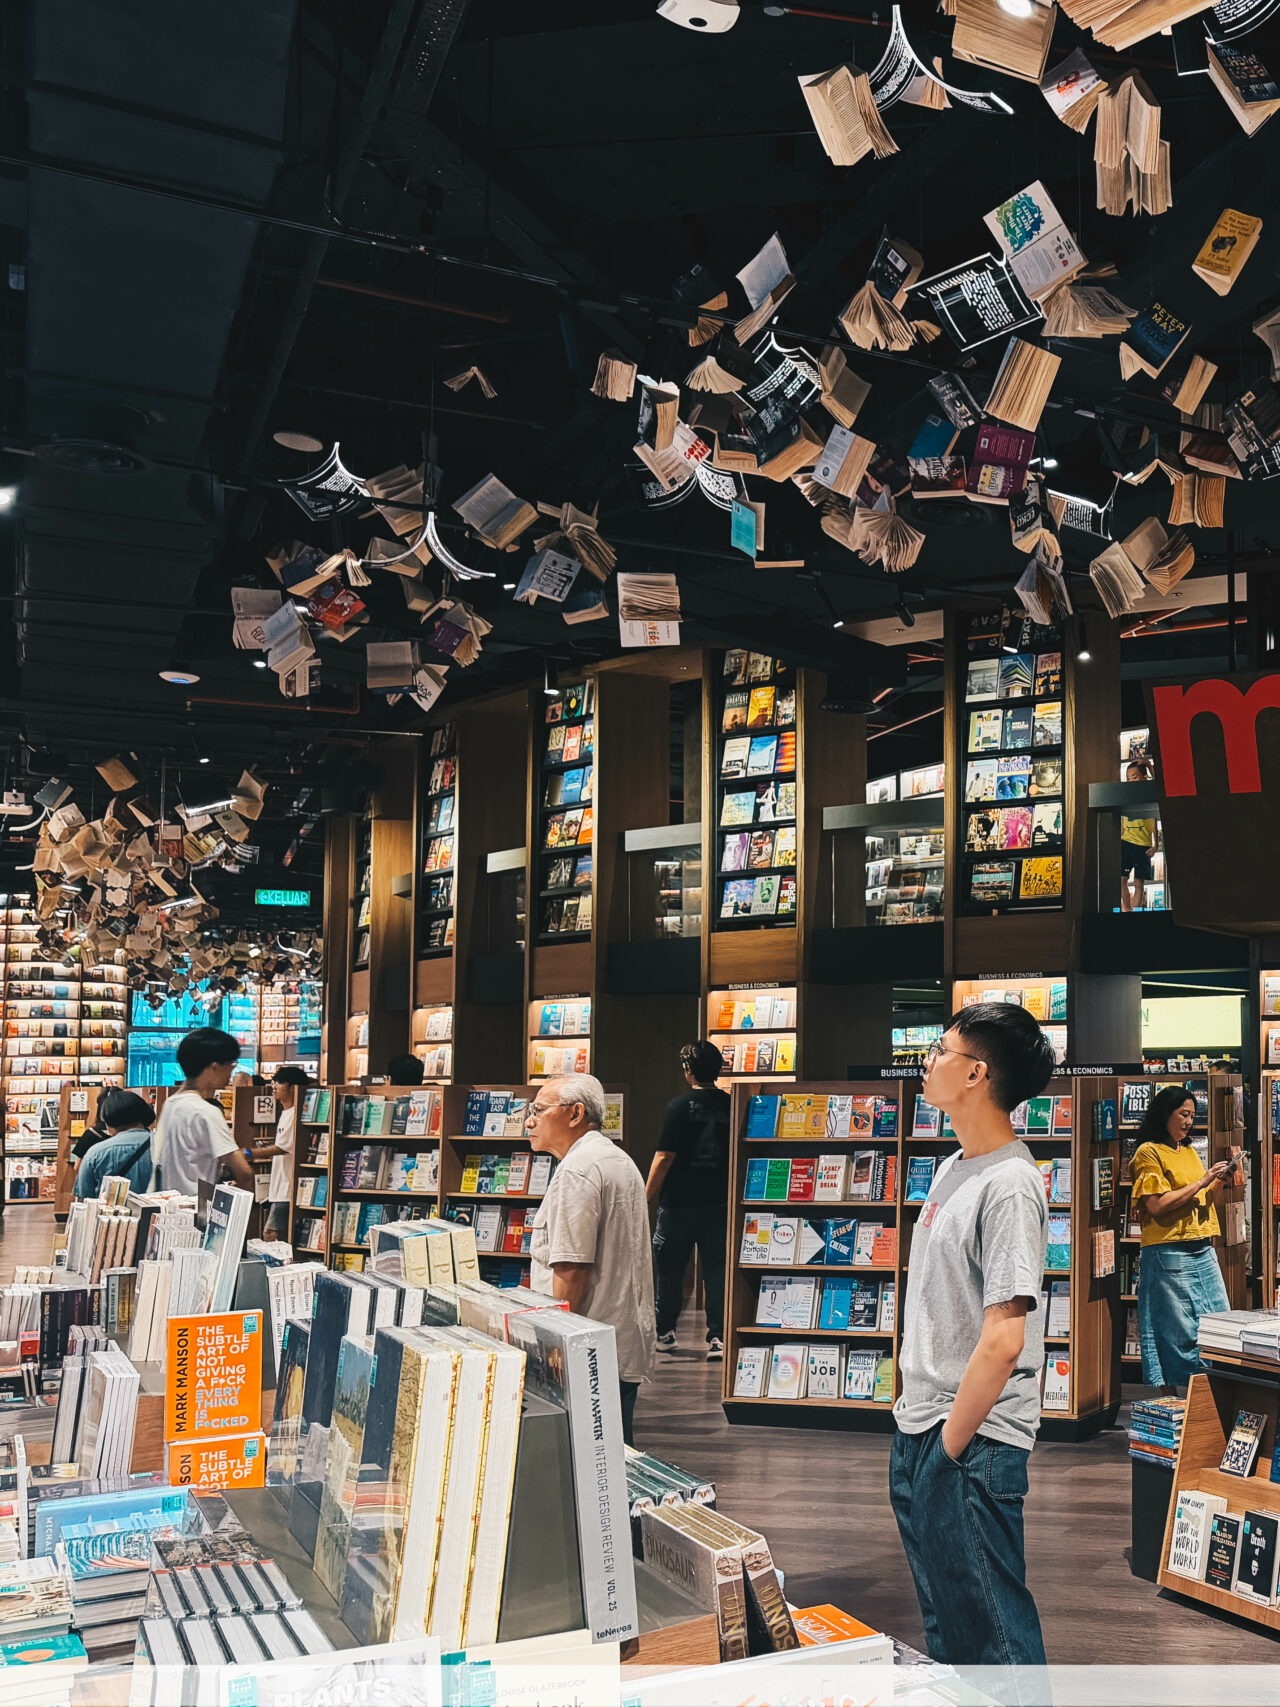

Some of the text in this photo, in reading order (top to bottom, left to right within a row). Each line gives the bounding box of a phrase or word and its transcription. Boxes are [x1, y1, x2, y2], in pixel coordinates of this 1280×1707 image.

[1152, 302, 1185, 332] PETER
[1152, 313, 1176, 334] MAY
[266, 891, 310, 905] KELUAR
[880, 1068, 918, 1077] BUSINESS
[1072, 1066, 1113, 1075] ECONOMICS
[1123, 1083, 1150, 1098] POSS
[489, 1104, 504, 1113] EASY
[1128, 1098, 1149, 1111] IBLE
[469, 1114, 480, 1122] THE
[769, 1160, 789, 1170] YOU
[910, 1165, 932, 1175] QUIET
[875, 1157, 886, 1201] Innovation
[743, 1239, 755, 1247] The
[743, 1246, 768, 1254] Portfolio
[756, 1252, 767, 1260] Life
[196, 1325, 224, 1337] THE
[196, 1333, 250, 1347] SUBTLE
[196, 1344, 250, 1357] ART OF
[196, 1355, 226, 1368] NOT
[849, 1356, 874, 1365] PROJECT
[196, 1365, 246, 1378] GIVING
[810, 1365, 837, 1376] JOB
[175, 1327, 189, 1433] MARK MANSON
[195, 1378, 206, 1389] A
[196, 1386, 241, 1399] EVERY
[196, 1396, 239, 1410] THING
[195, 1409, 207, 1420] IS
[200, 1450, 228, 1462] THE
[199, 1458, 254, 1473] SUBTLE
[199, 1468, 253, 1484] ART OF
[587, 1347, 618, 1613] ANDREW MARTIN INTERIOR DESIGN REVIEW VOL. 25
[1176, 1521, 1190, 1536] HOW
[1175, 1536, 1200, 1552] WORLD
[646, 1533, 696, 1589] DINOSAUR
[1173, 1553, 1198, 1570] WORKS
[596, 1622, 632, 1640] teNeues
[497, 1679, 588, 1699] LOUISE GLAZEBROOK
